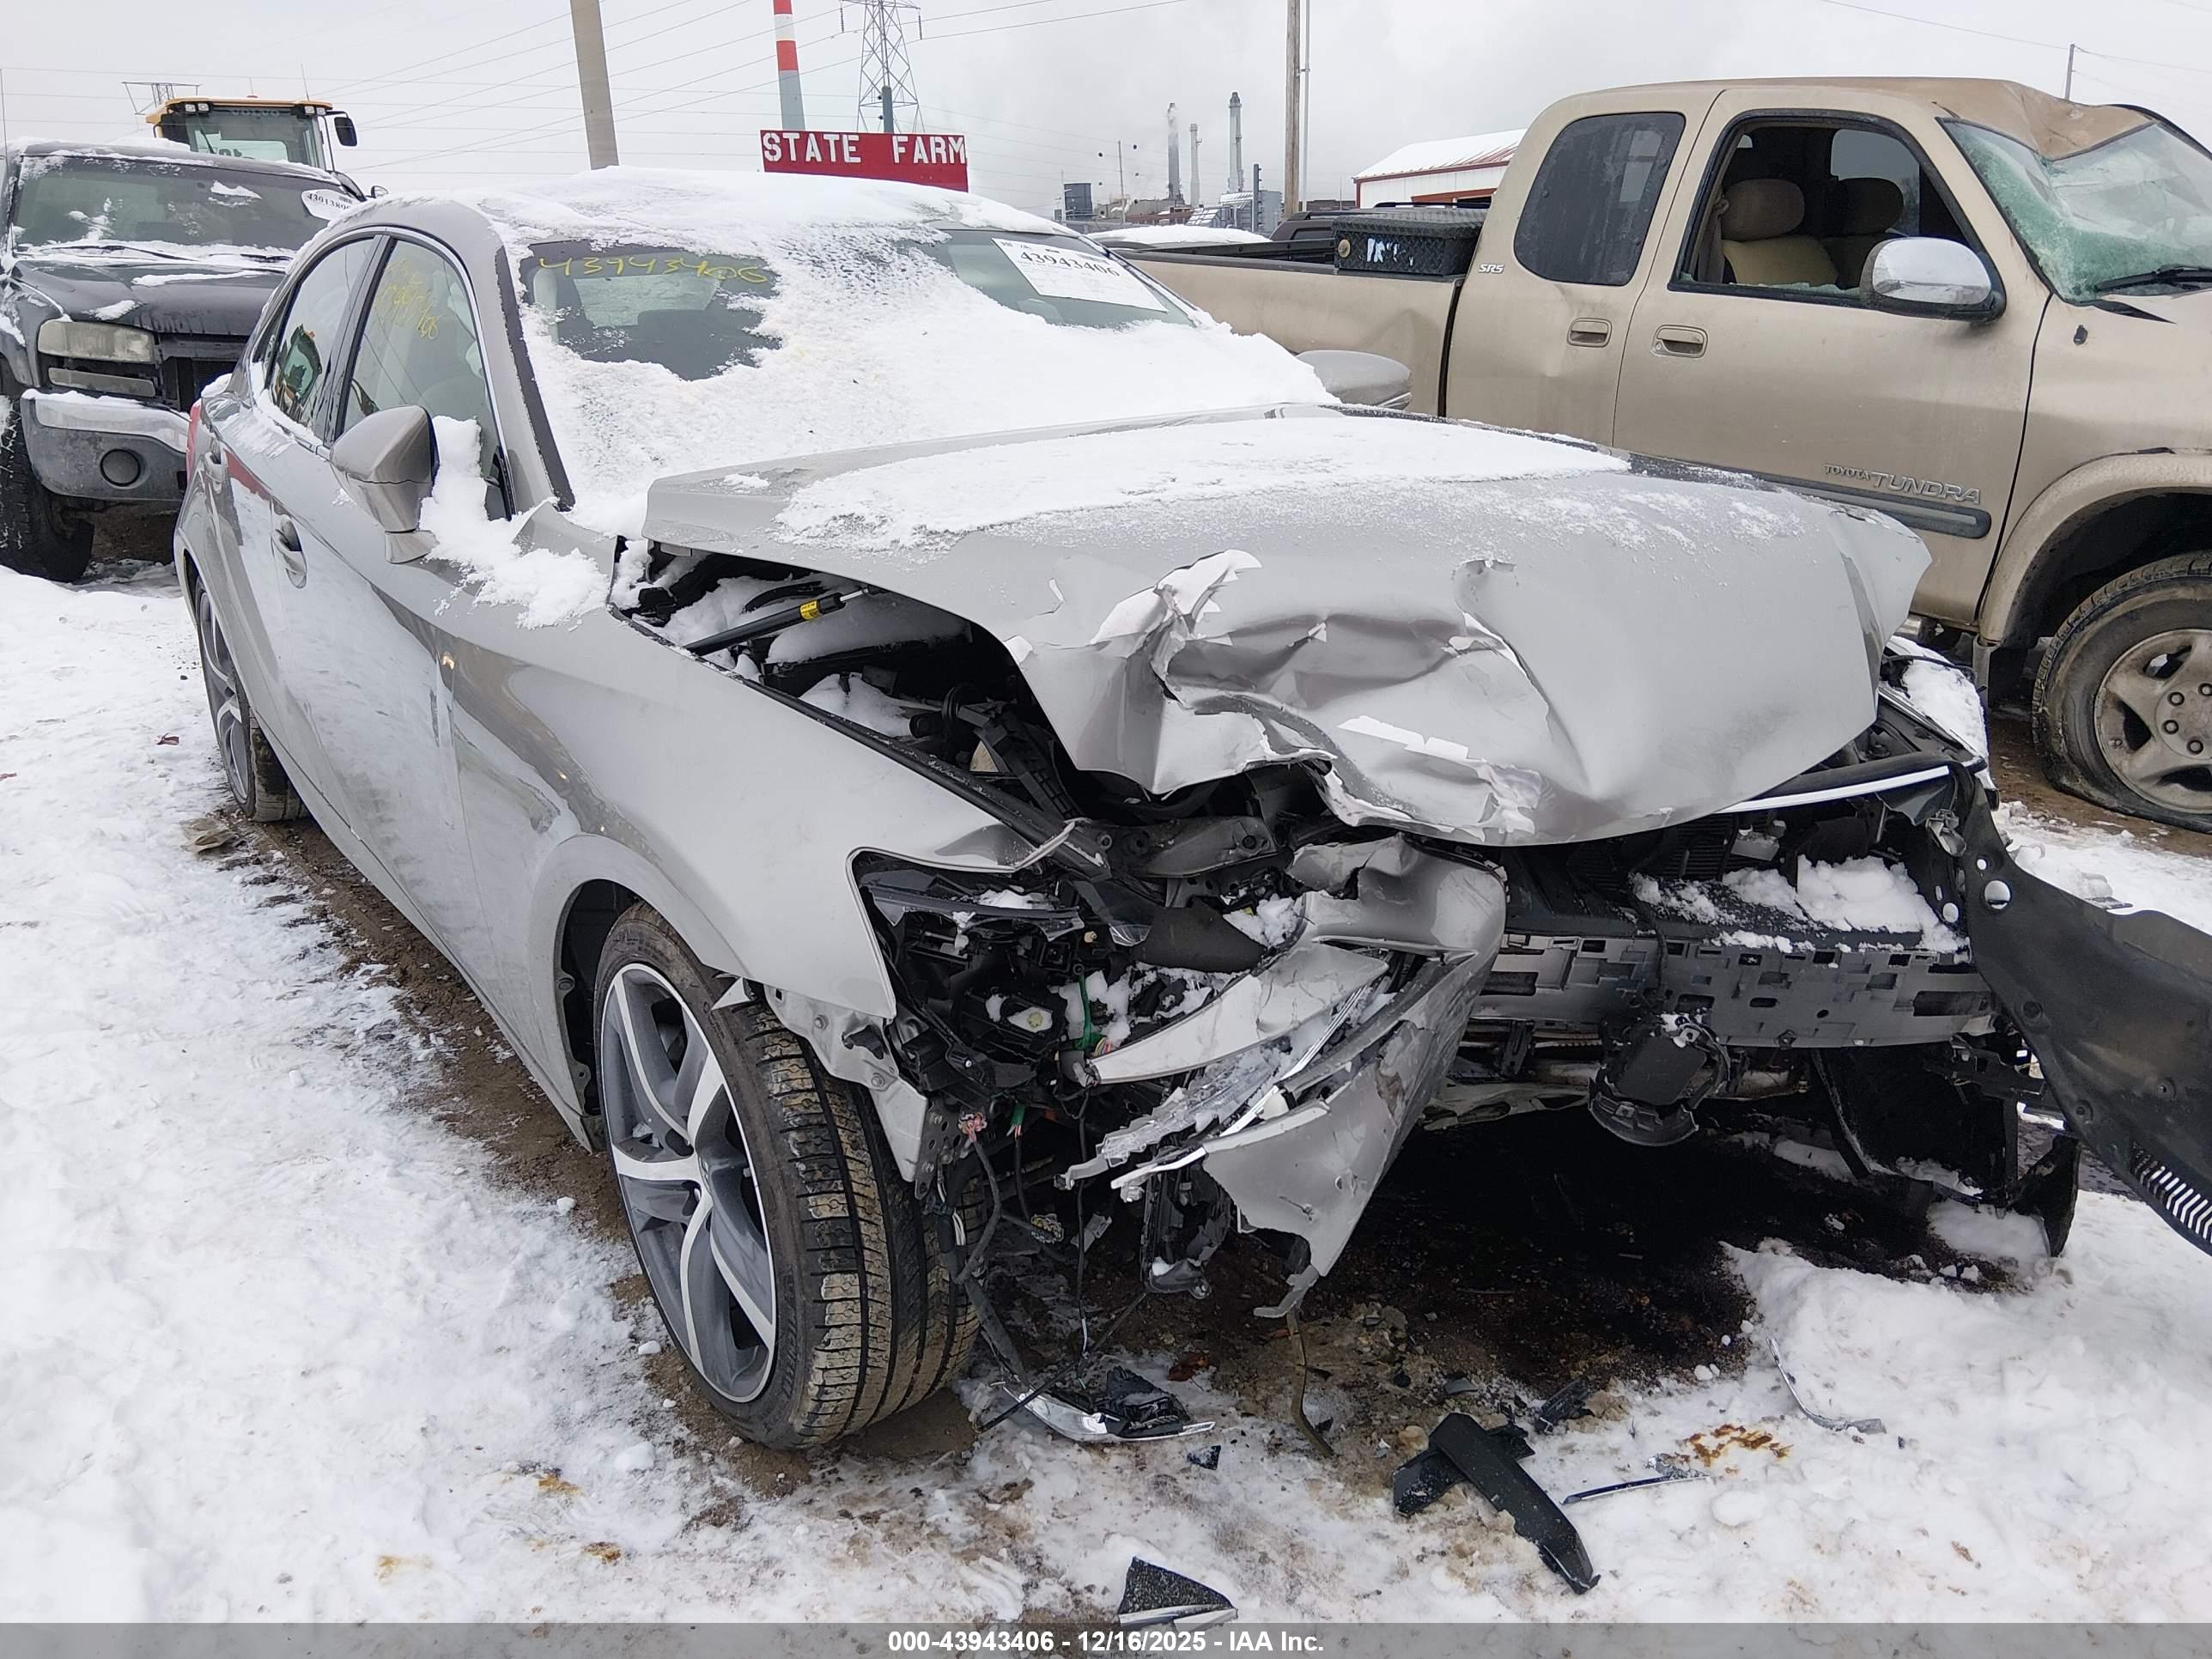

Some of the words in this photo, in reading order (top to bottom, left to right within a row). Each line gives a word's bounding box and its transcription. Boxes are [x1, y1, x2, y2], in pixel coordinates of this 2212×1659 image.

[762, 132, 861, 164] STATE
[892, 135, 967, 165] FARM
[1020, 252, 1121, 276] 43943406
[1825, 464, 1870, 481] TOYOTA
[1870, 471, 1981, 505] TUNDRA
